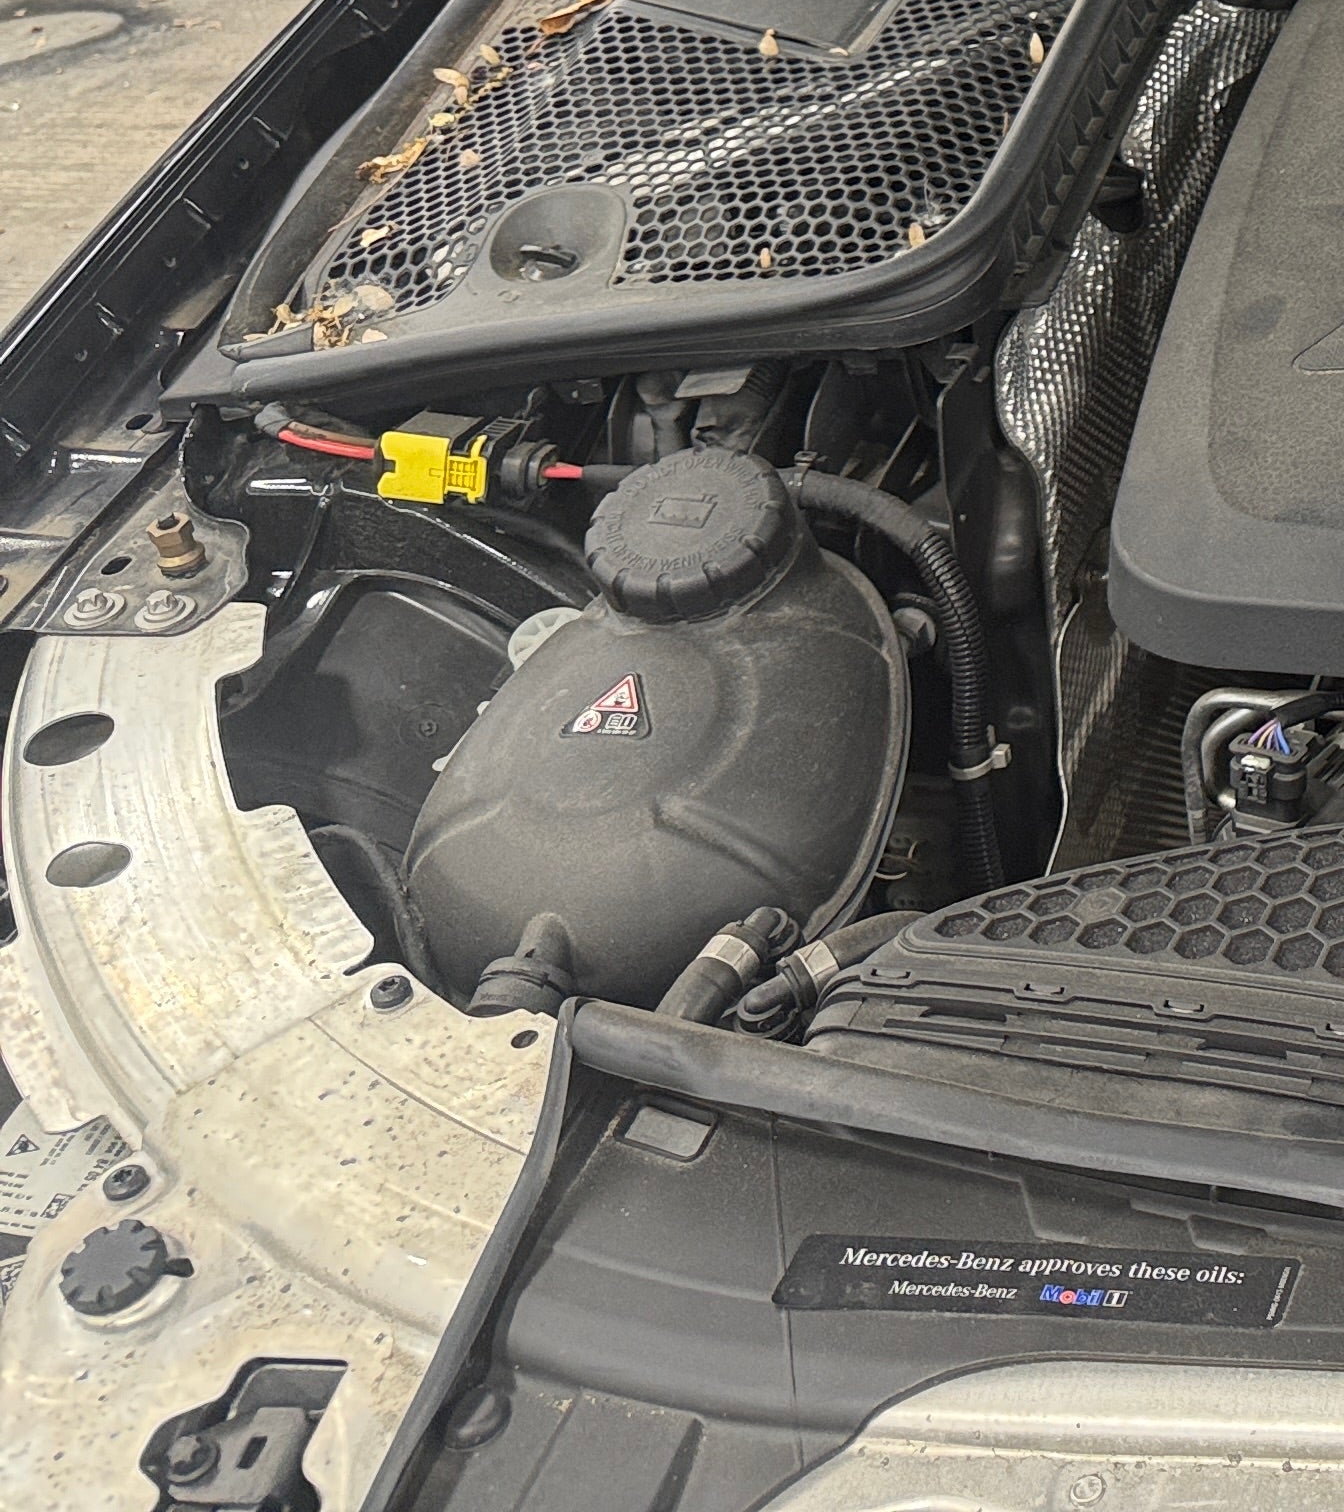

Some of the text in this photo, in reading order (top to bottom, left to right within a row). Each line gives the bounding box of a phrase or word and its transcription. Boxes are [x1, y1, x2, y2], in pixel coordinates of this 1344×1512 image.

[838, 1247, 1246, 1285] Mercedes-Benz approves these oils:
[888, 1280, 1018, 1300] Mercedes-Benz
[1040, 1284, 1105, 1307] Mobil
